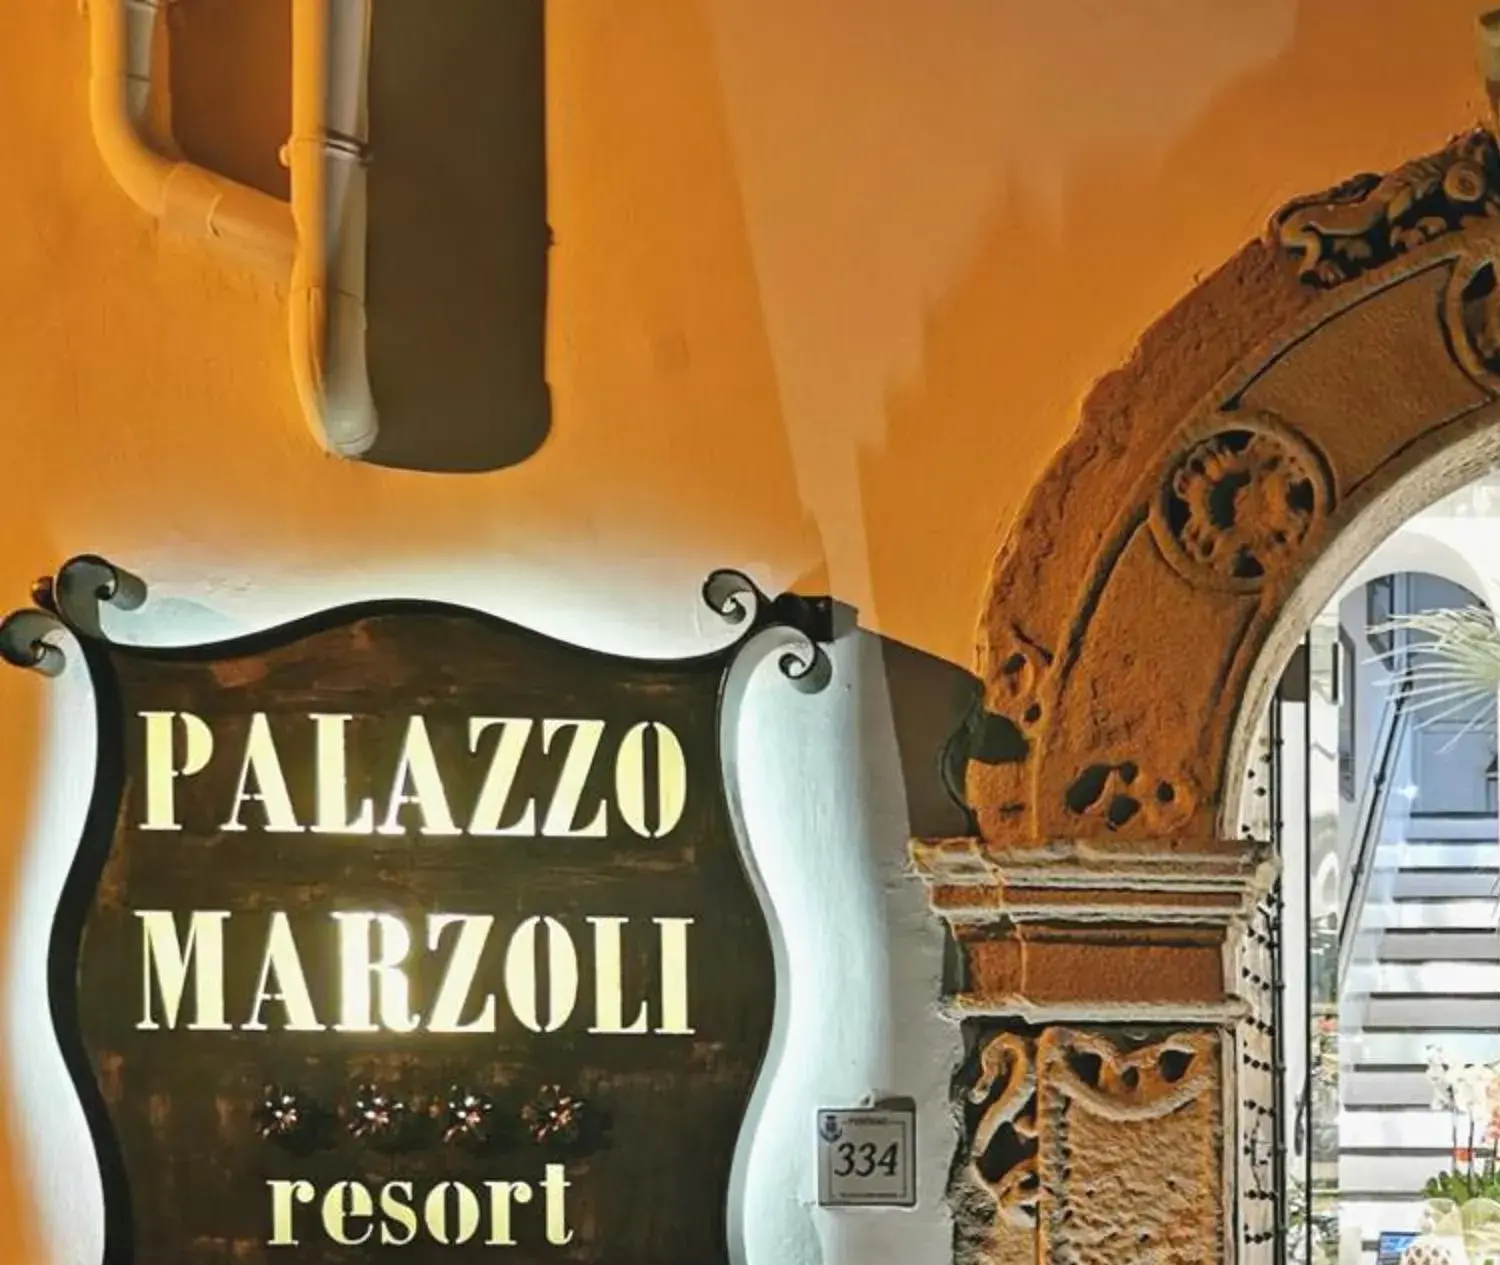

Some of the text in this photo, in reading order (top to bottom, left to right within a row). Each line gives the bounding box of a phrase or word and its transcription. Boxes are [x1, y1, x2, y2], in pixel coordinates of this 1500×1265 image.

[139, 711, 687, 838] PALAZZO
[135, 909, 695, 1036] MARZOLI
[266, 1163, 574, 1245] resort
[834, 1142, 898, 1177] 334
